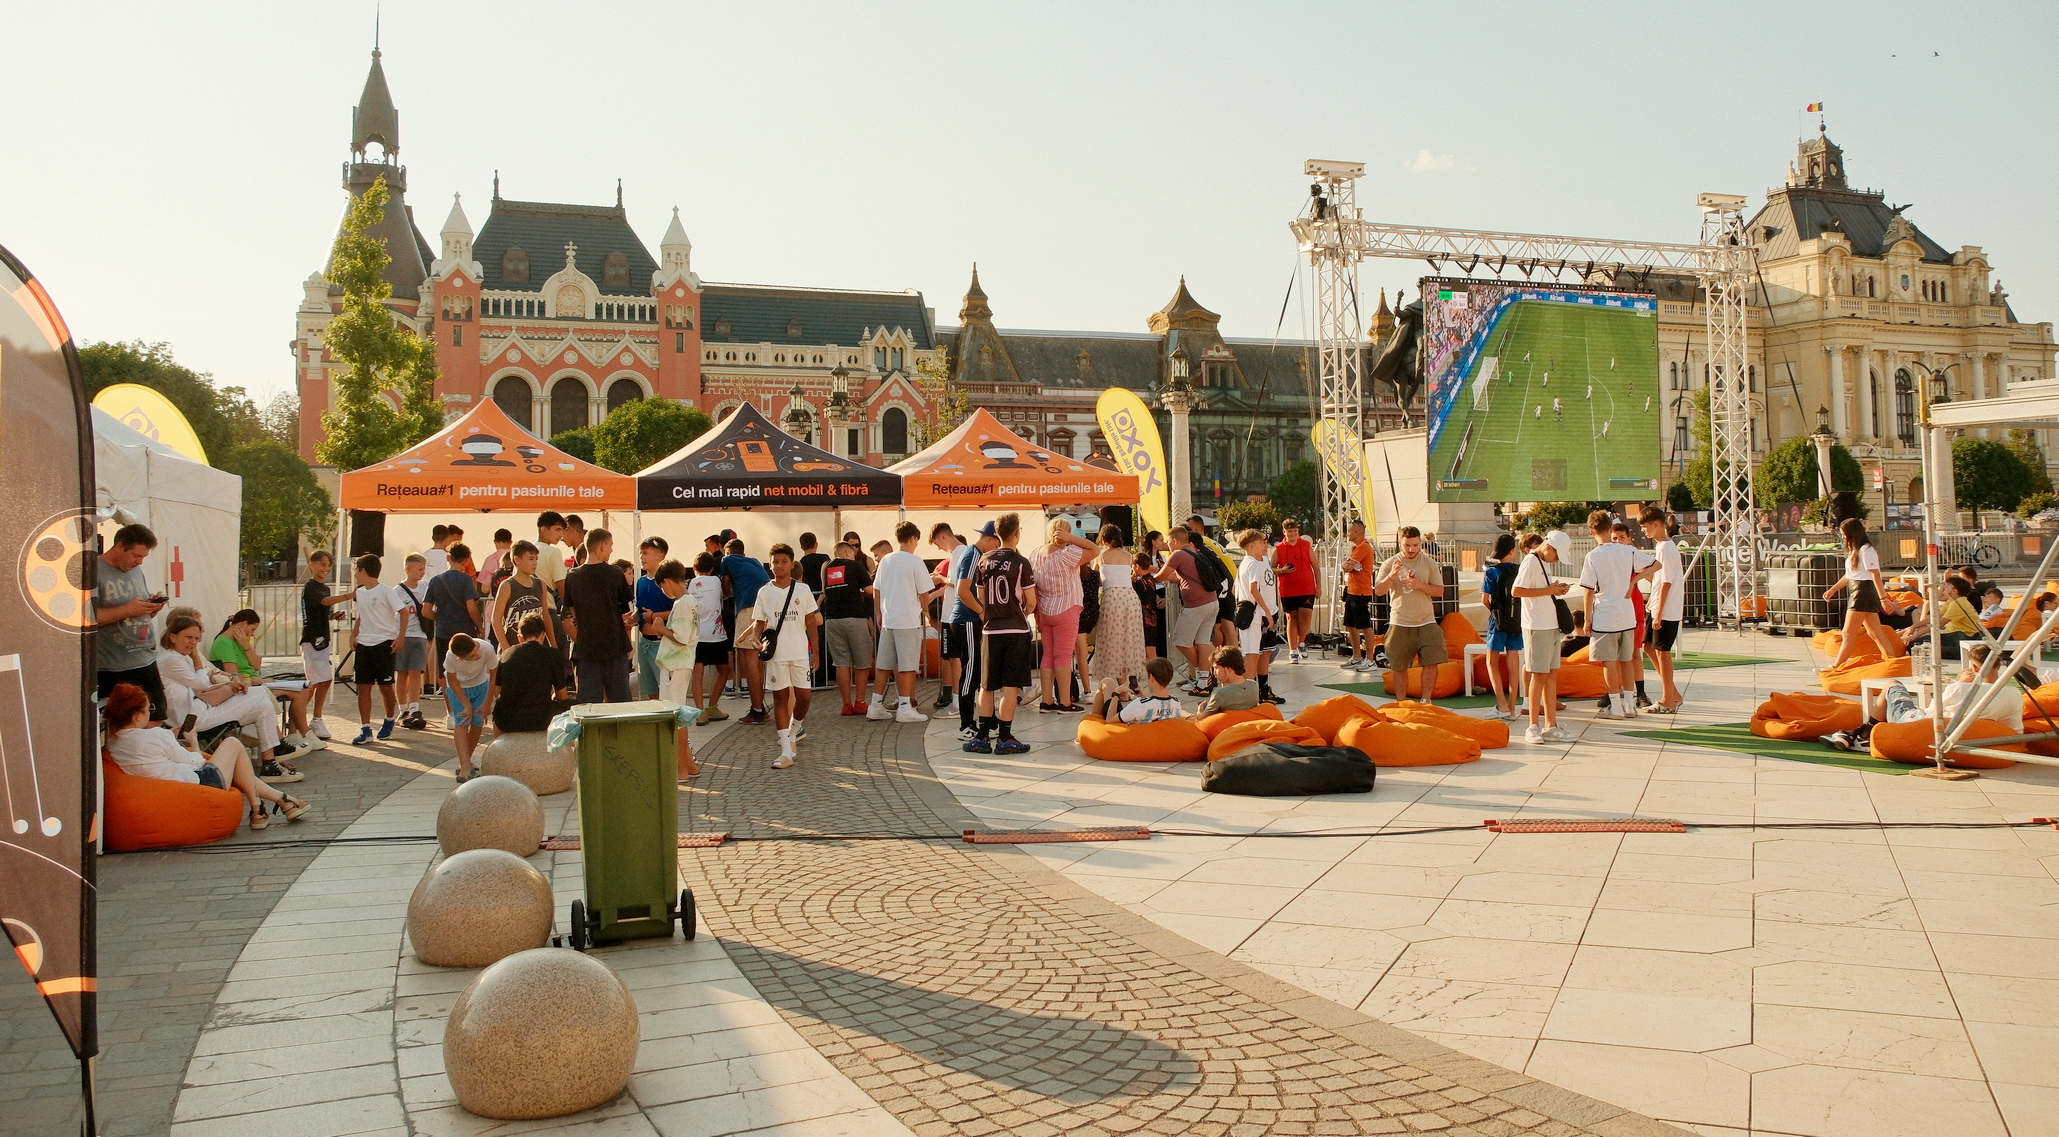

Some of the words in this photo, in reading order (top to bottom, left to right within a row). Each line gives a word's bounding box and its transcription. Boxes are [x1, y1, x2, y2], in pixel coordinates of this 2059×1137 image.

[377, 483, 454, 500] Rețeaua#1
[459, 485, 507, 499] pentru
[511, 485, 576, 499] pasiunile
[578, 486, 605, 498] tale
[672, 486, 695, 499] Cel
[698, 485, 723, 498] mai
[726, 485, 760, 500] rapid
[763, 485, 785, 496] net
[788, 484, 824, 496] mobil
[827, 484, 837, 496] &
[840, 483, 869, 496] fibră
[932, 483, 994, 498] Rețeaua#1
[998, 483, 1036, 496] pentru
[1039, 483, 1091, 496] pasiunile
[1093, 482, 1114, 493] tale
[988, 574, 1010, 605] 10
